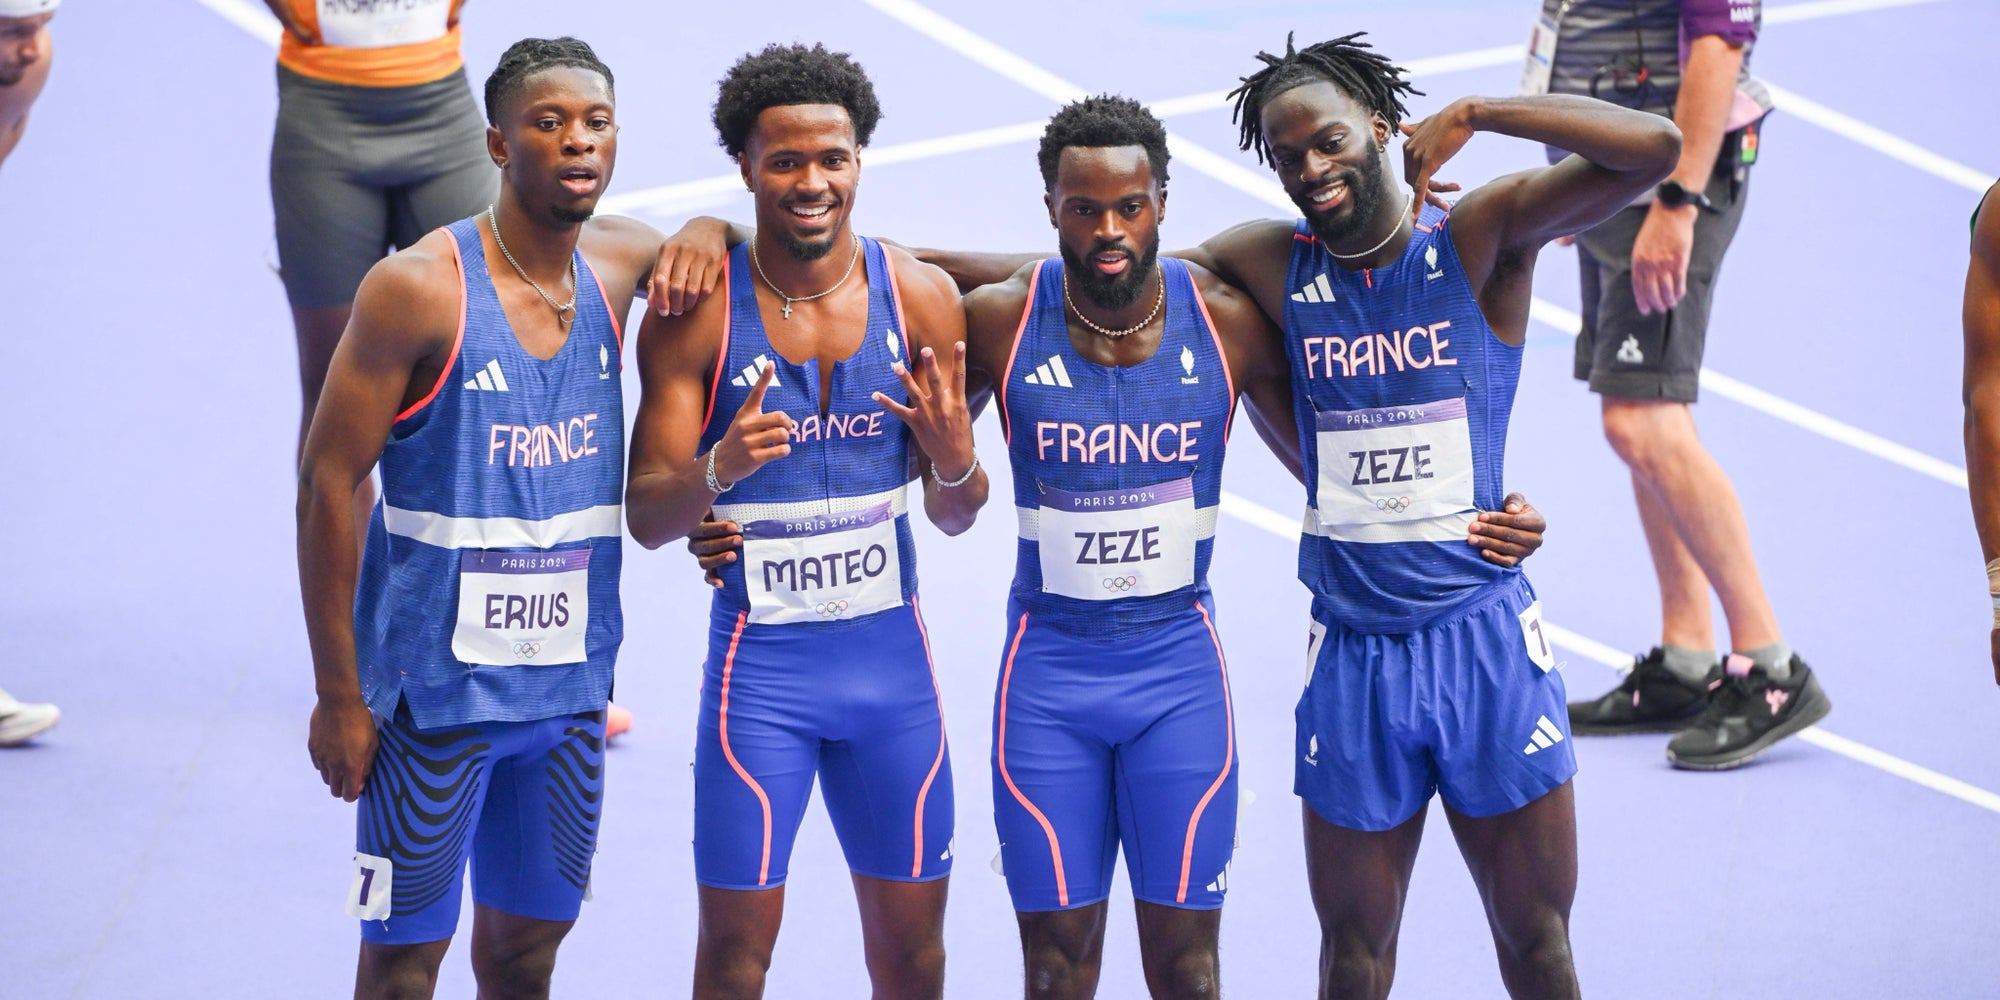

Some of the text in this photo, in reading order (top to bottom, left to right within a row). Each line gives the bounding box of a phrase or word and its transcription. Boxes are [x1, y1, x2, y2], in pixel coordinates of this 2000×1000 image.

[1303, 320, 1458, 379] FRANCE
[789, 411, 885, 443] RANCE
[1347, 408, 1425, 425] PARIS 2024
[488, 413, 598, 468] FRANCE
[1036, 421, 1202, 464] FRANCE
[1348, 444, 1434, 486] ZEZE
[1074, 491, 1155, 507] PARIS 2024
[786, 515, 865, 533] PARIS 2024
[501, 557, 567, 569] PARIS 2024
[1075, 526, 1161, 565] ZEZE
[763, 544, 887, 592] MATEO
[484, 592, 570, 630] ERIUS
